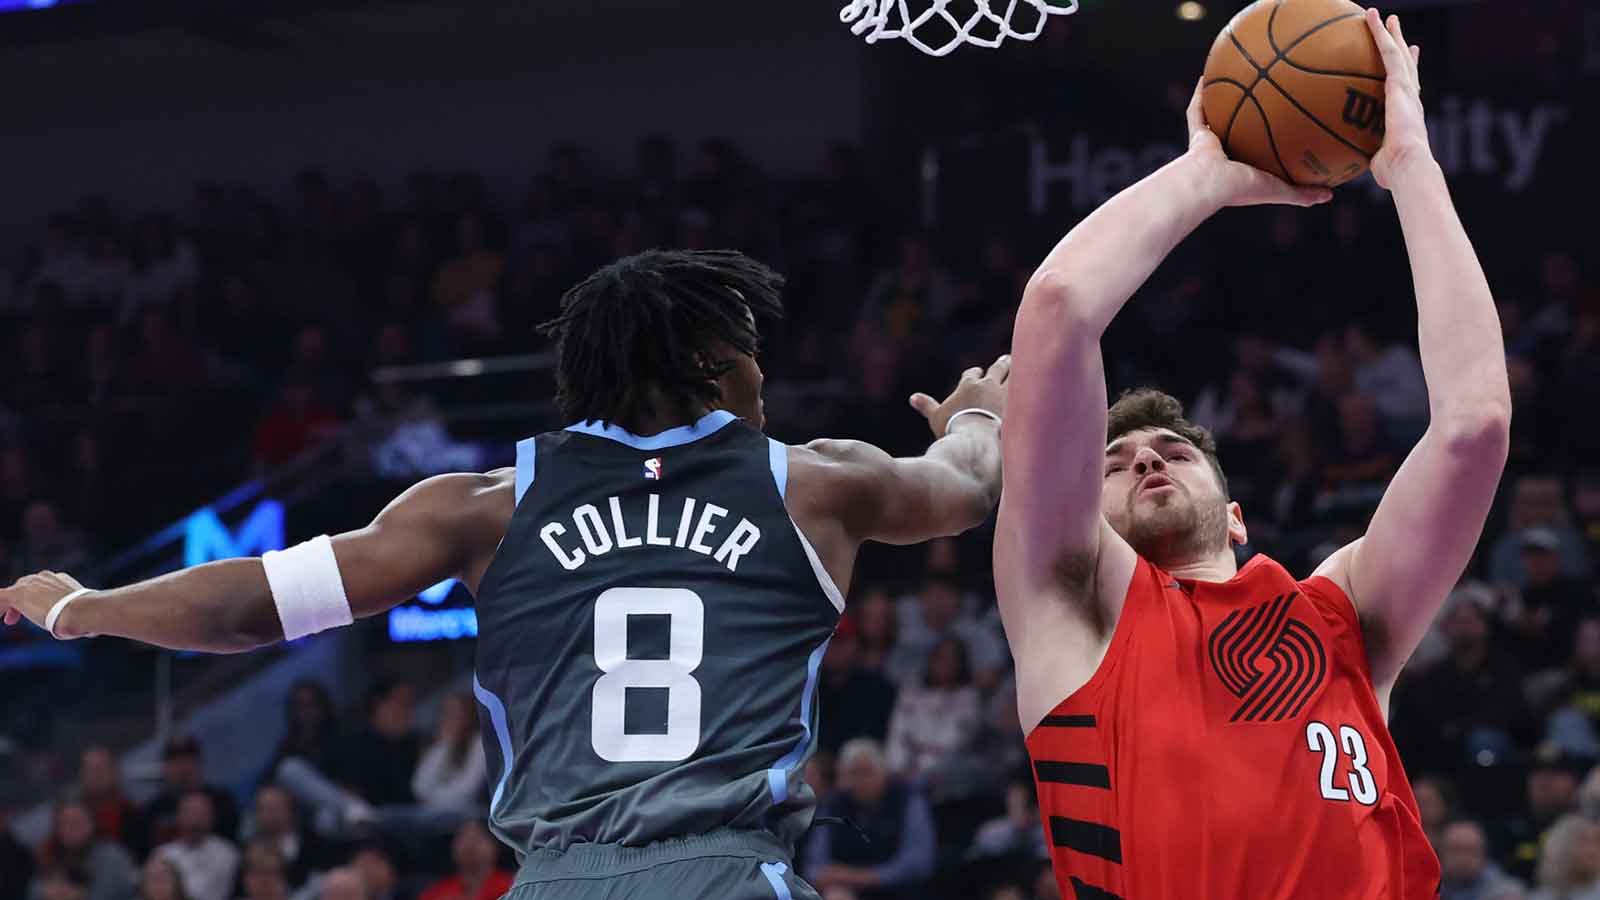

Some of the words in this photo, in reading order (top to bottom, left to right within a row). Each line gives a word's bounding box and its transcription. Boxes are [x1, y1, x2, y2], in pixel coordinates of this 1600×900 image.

[540, 493, 761, 572] COLLIER
[591, 587, 704, 762] 8
[1306, 721, 1379, 806] 23
